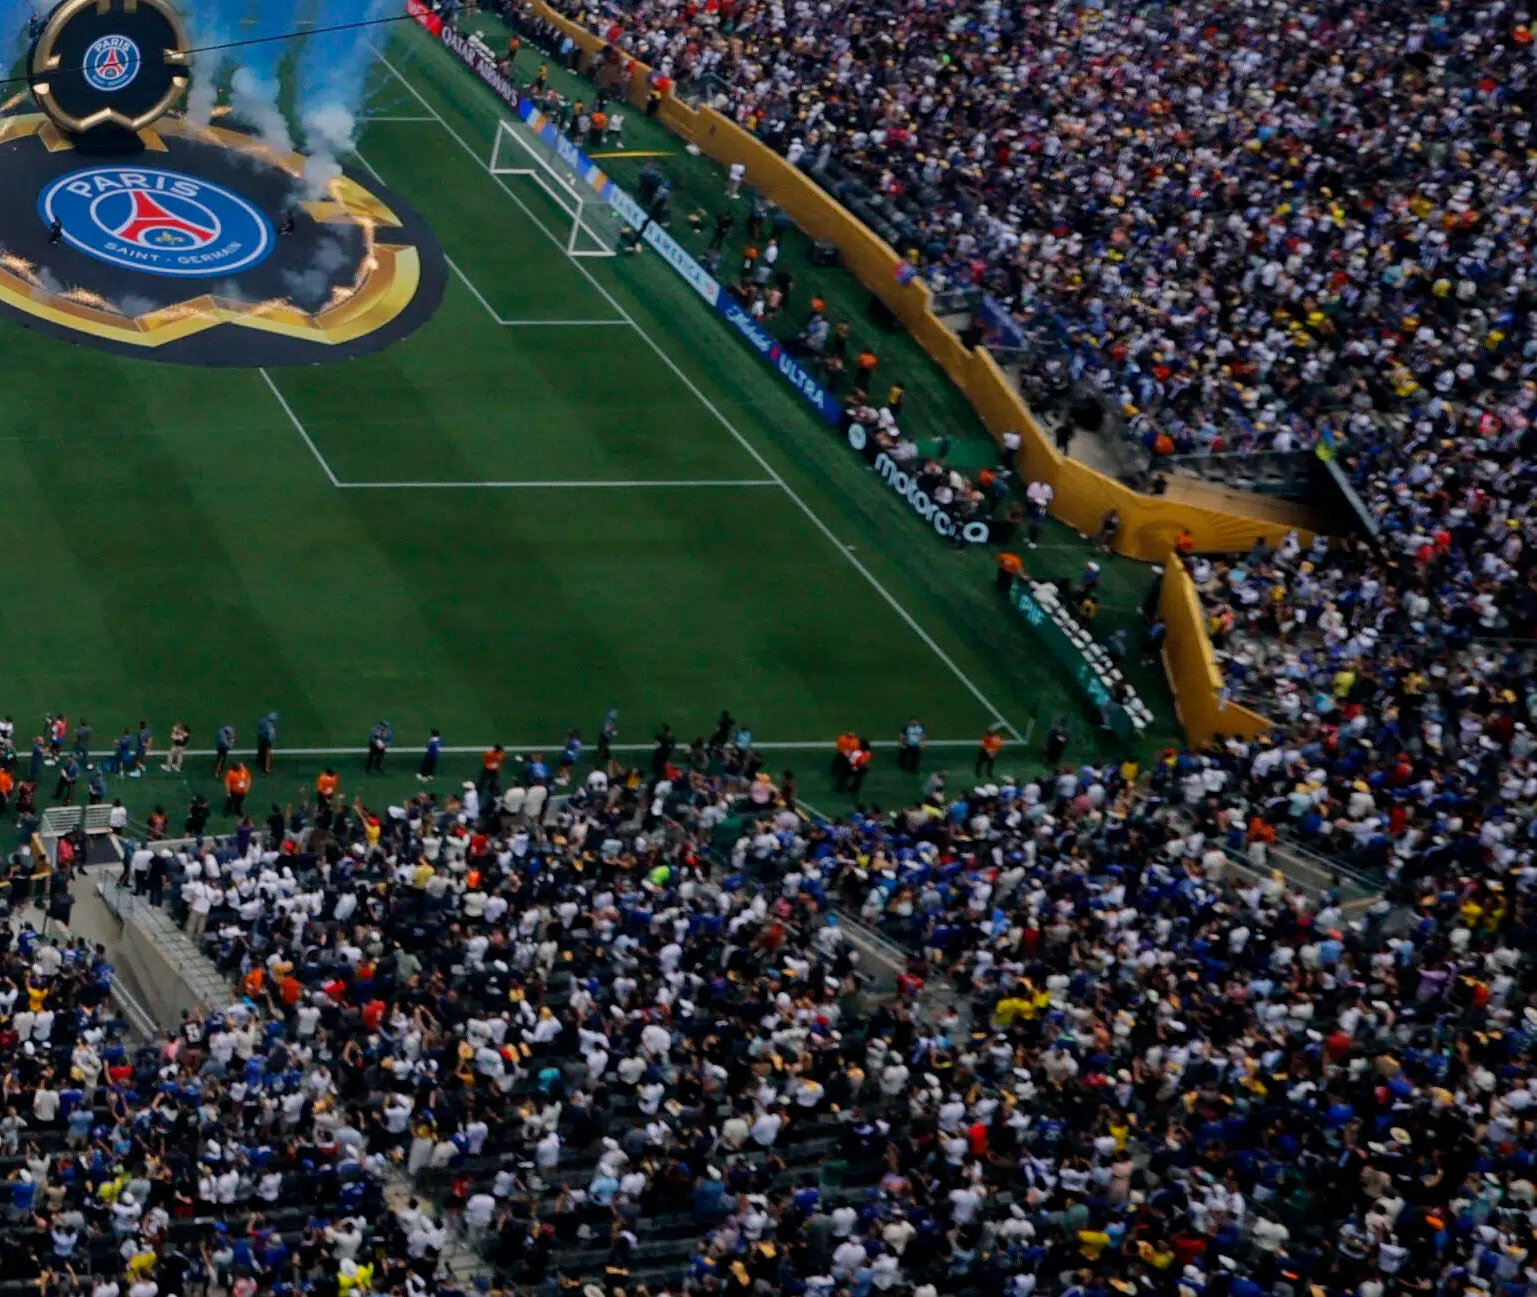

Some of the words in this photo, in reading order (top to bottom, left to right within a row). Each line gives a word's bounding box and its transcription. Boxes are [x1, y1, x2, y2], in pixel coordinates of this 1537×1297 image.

[95, 38, 131, 52] PARIS
[441, 26, 476, 66] QATAR
[477, 61, 519, 106] AIRWAYS
[65, 173, 200, 198] PARIS
[779, 354, 826, 409] ULTRA
